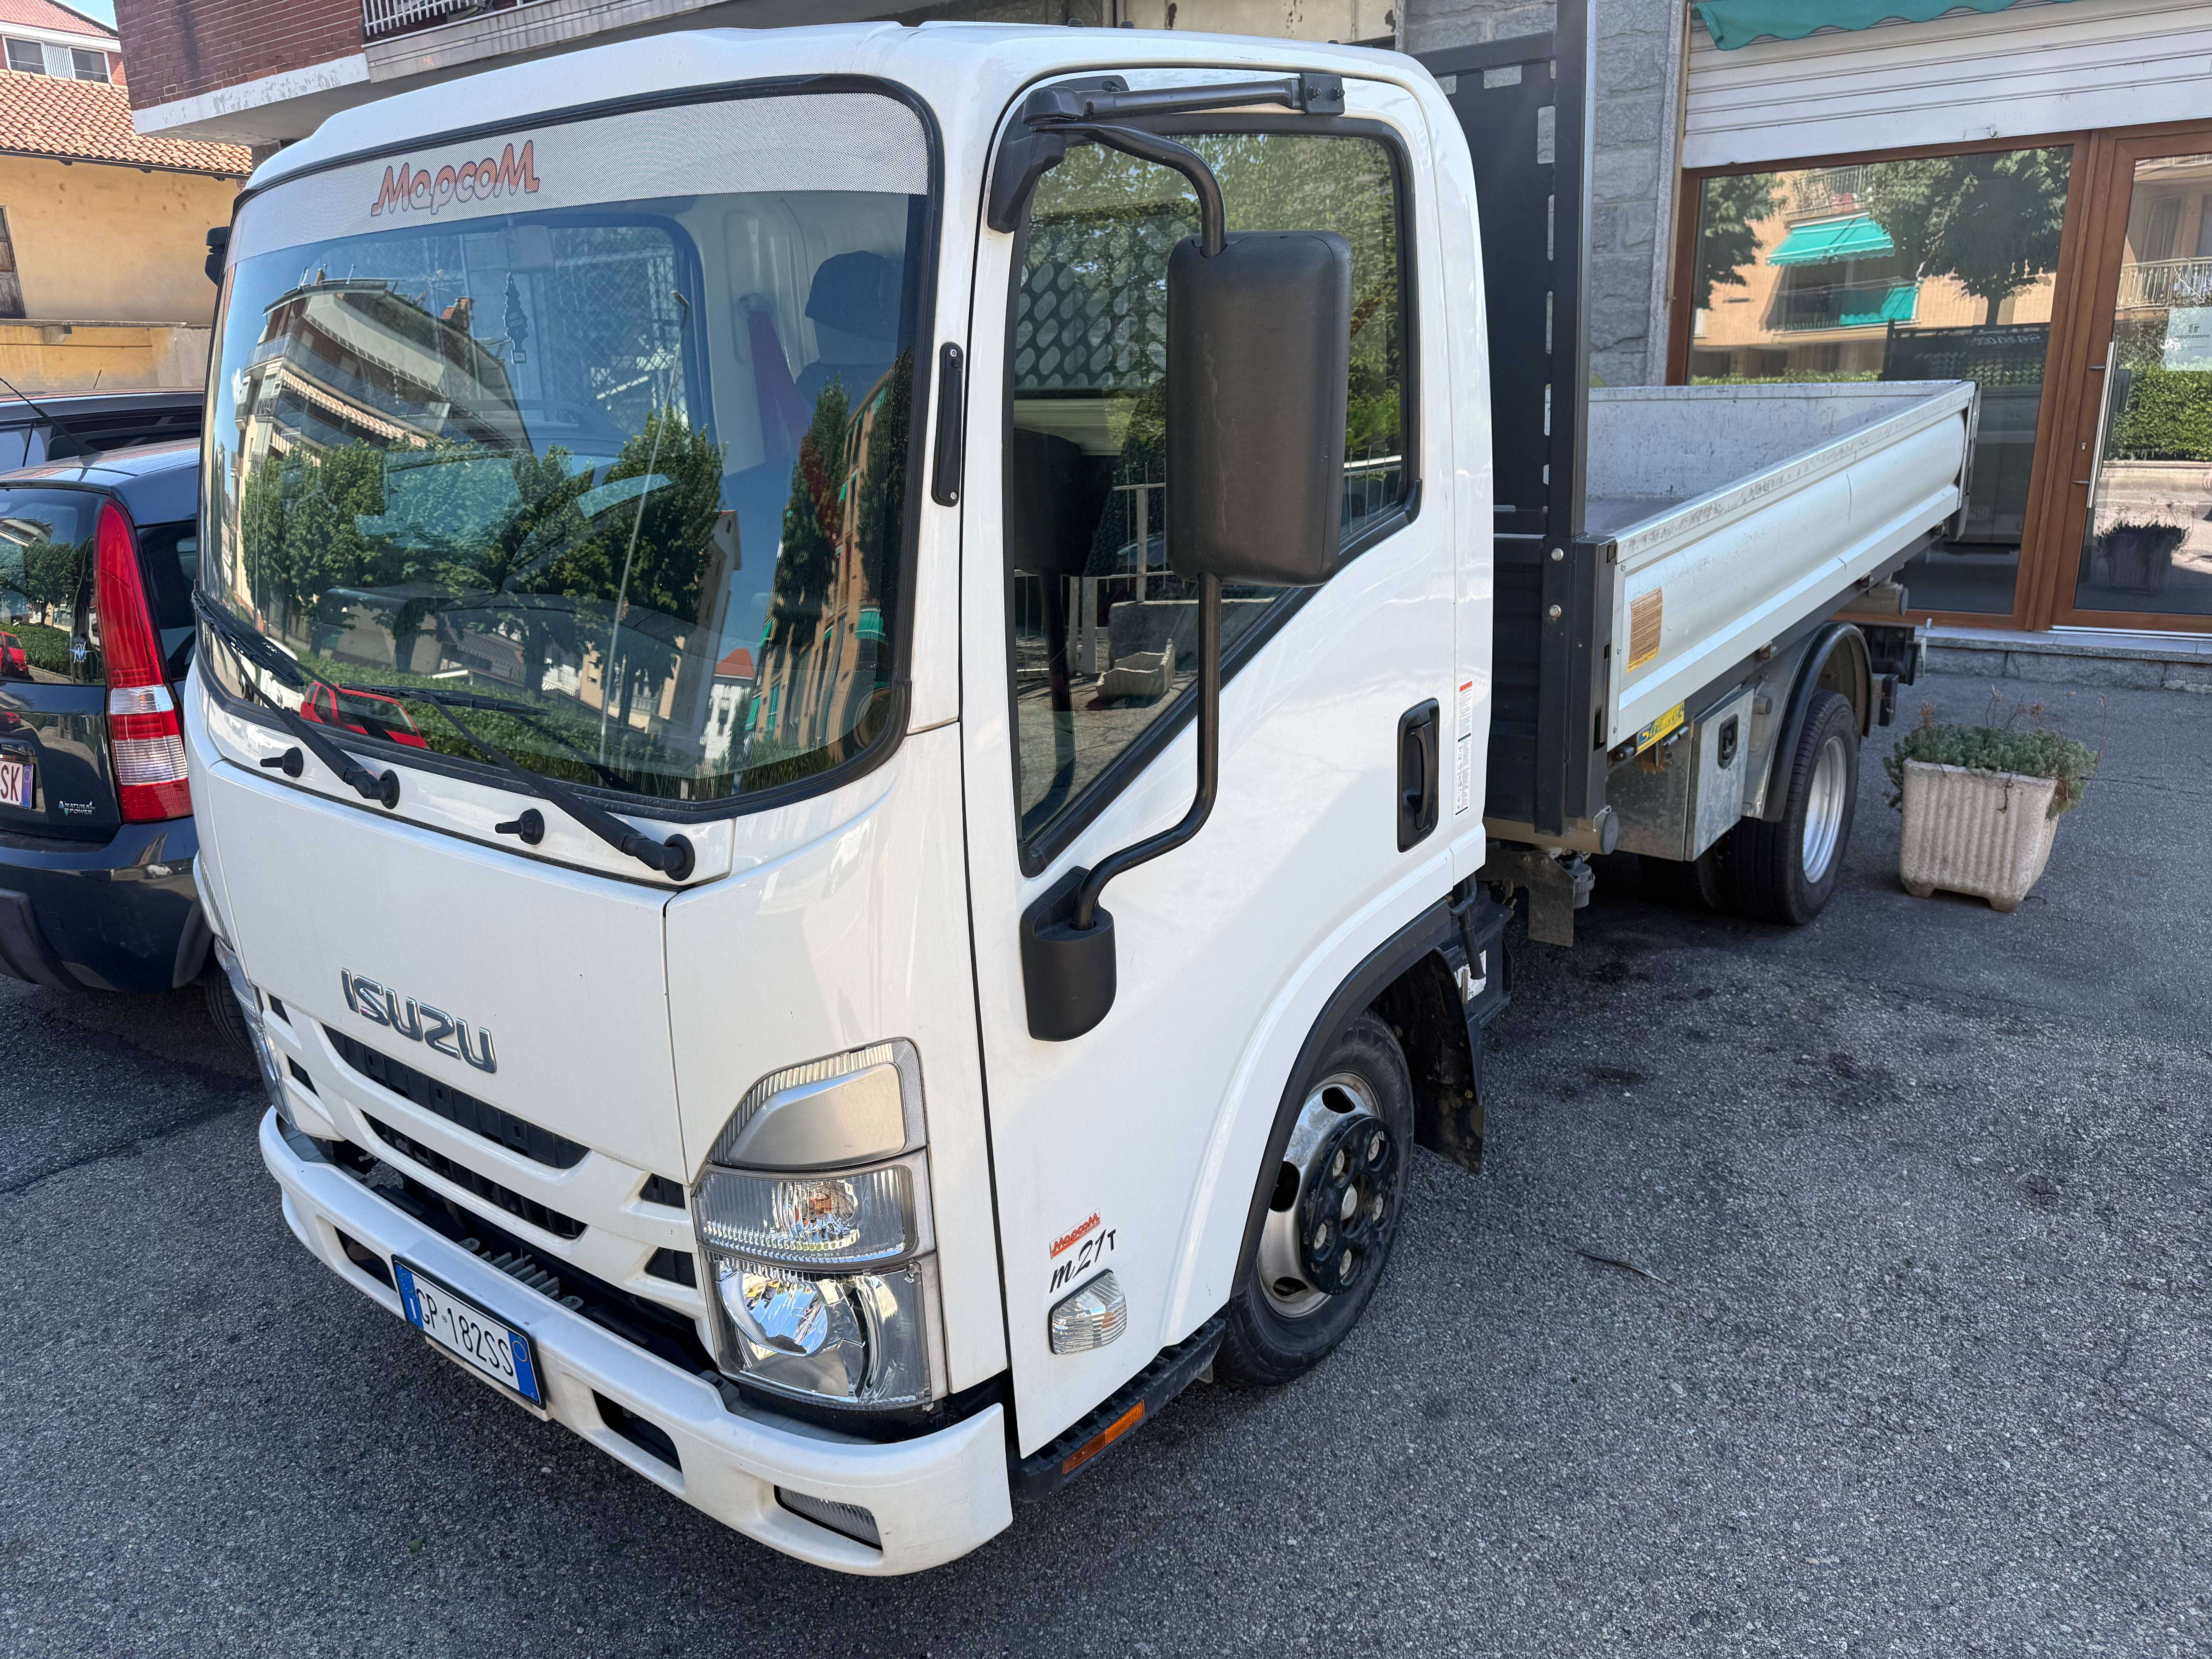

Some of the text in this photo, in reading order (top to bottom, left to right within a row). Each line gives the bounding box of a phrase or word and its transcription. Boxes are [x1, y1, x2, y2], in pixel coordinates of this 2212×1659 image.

[65, 801, 96, 810] NATURAL
[341, 967, 497, 1074] ISUZU
[416, 1288, 437, 1329] GP
[447, 1308, 514, 1376] 182SS
